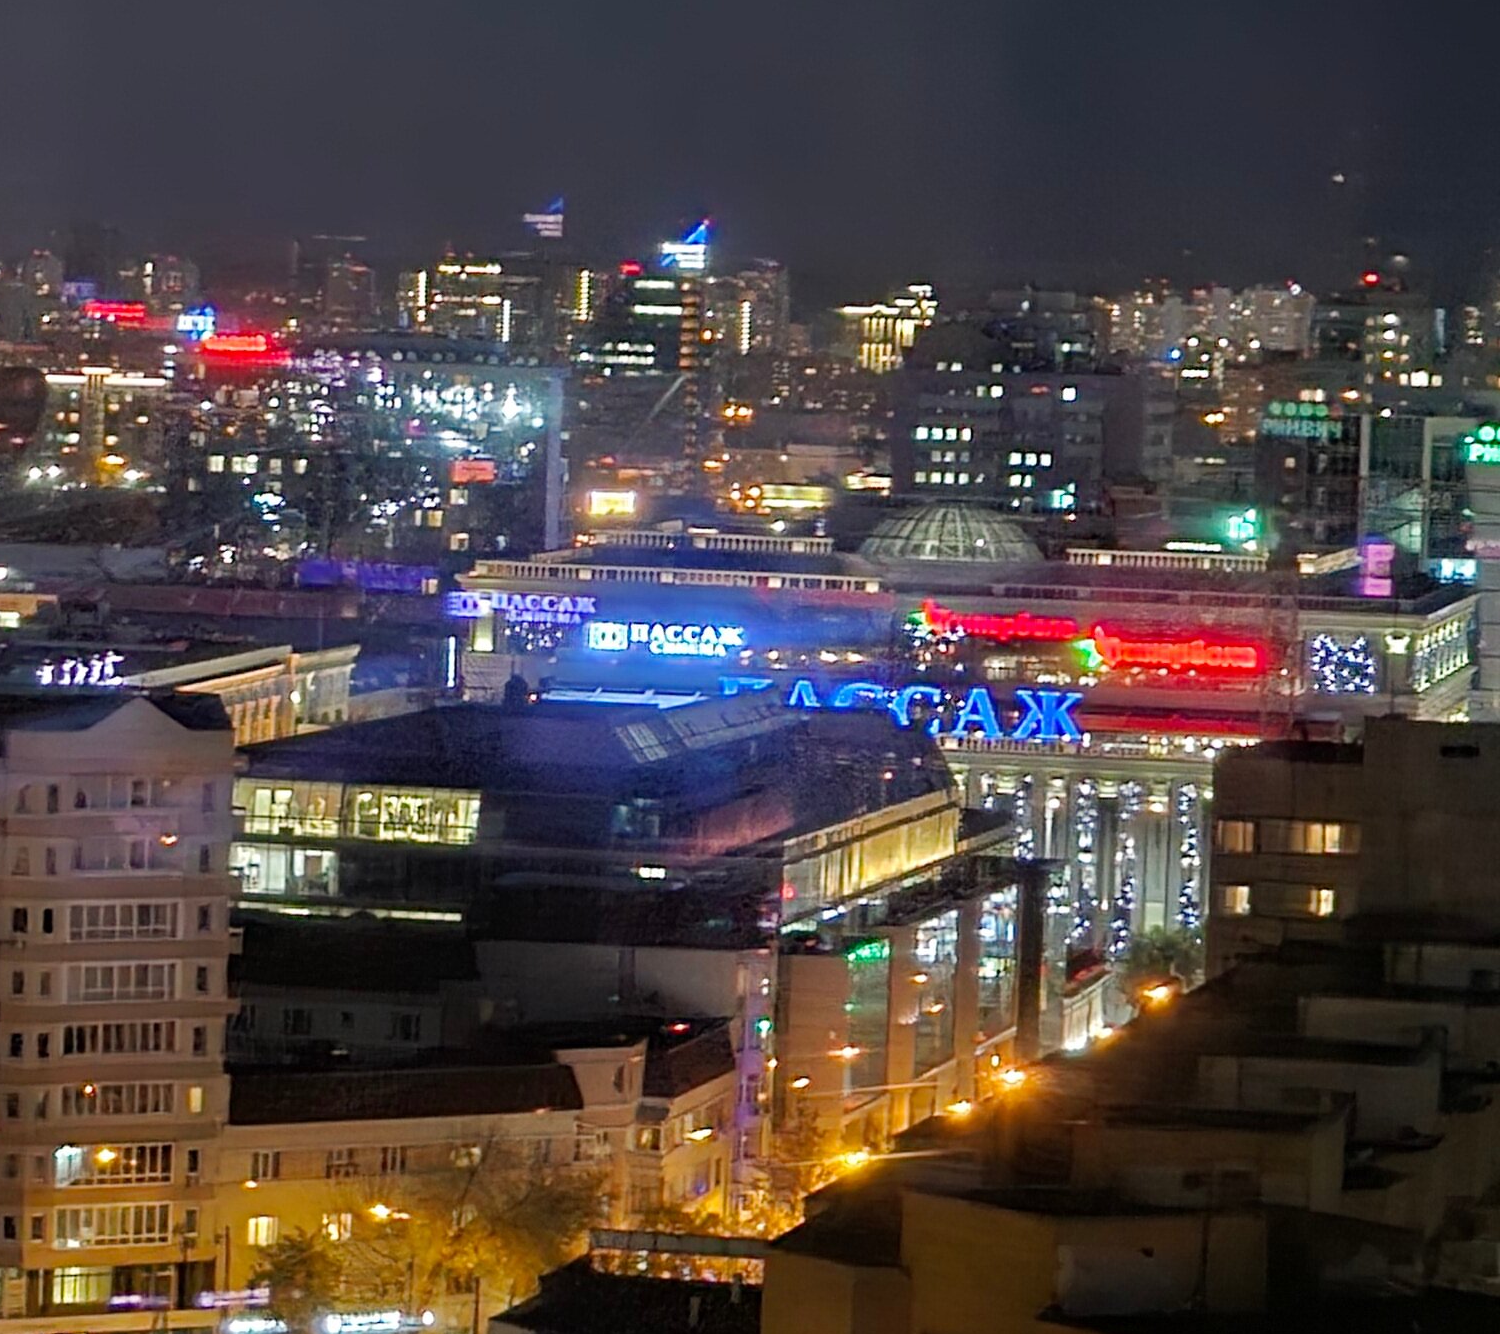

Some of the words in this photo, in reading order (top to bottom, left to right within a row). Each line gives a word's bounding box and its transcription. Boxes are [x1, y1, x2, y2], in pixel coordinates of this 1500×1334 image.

[491, 593, 596, 613] ПАССАЖ
[630, 623, 745, 646] ПАССАЖ
[719, 675, 1084, 741] АСАЖ
